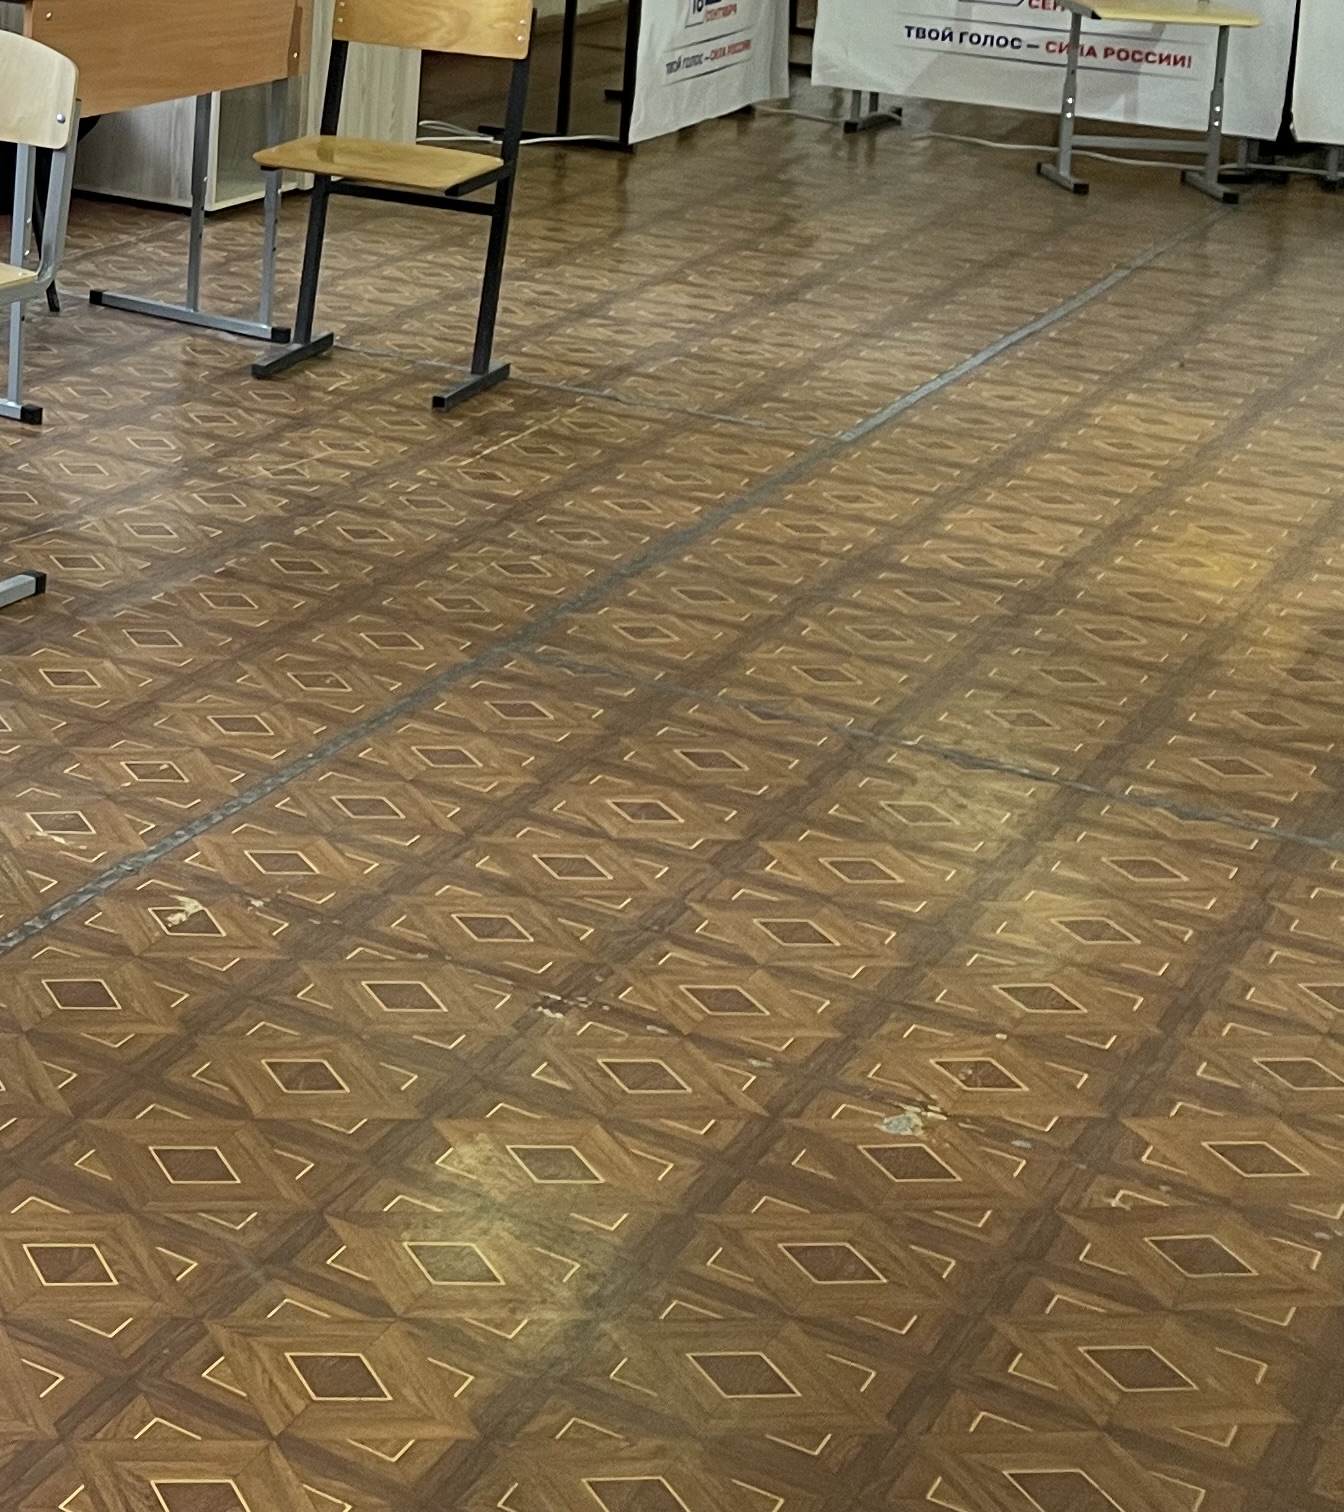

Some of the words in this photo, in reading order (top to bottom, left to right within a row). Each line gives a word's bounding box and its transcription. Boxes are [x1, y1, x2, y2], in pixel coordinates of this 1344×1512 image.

[904, 24, 954, 44] ТВОЙ
[959, 30, 1023, 50] ГОЛОС
[1045, 40, 1098, 59] СИА
[1103, 47, 1192, 69] РОССИИ!
